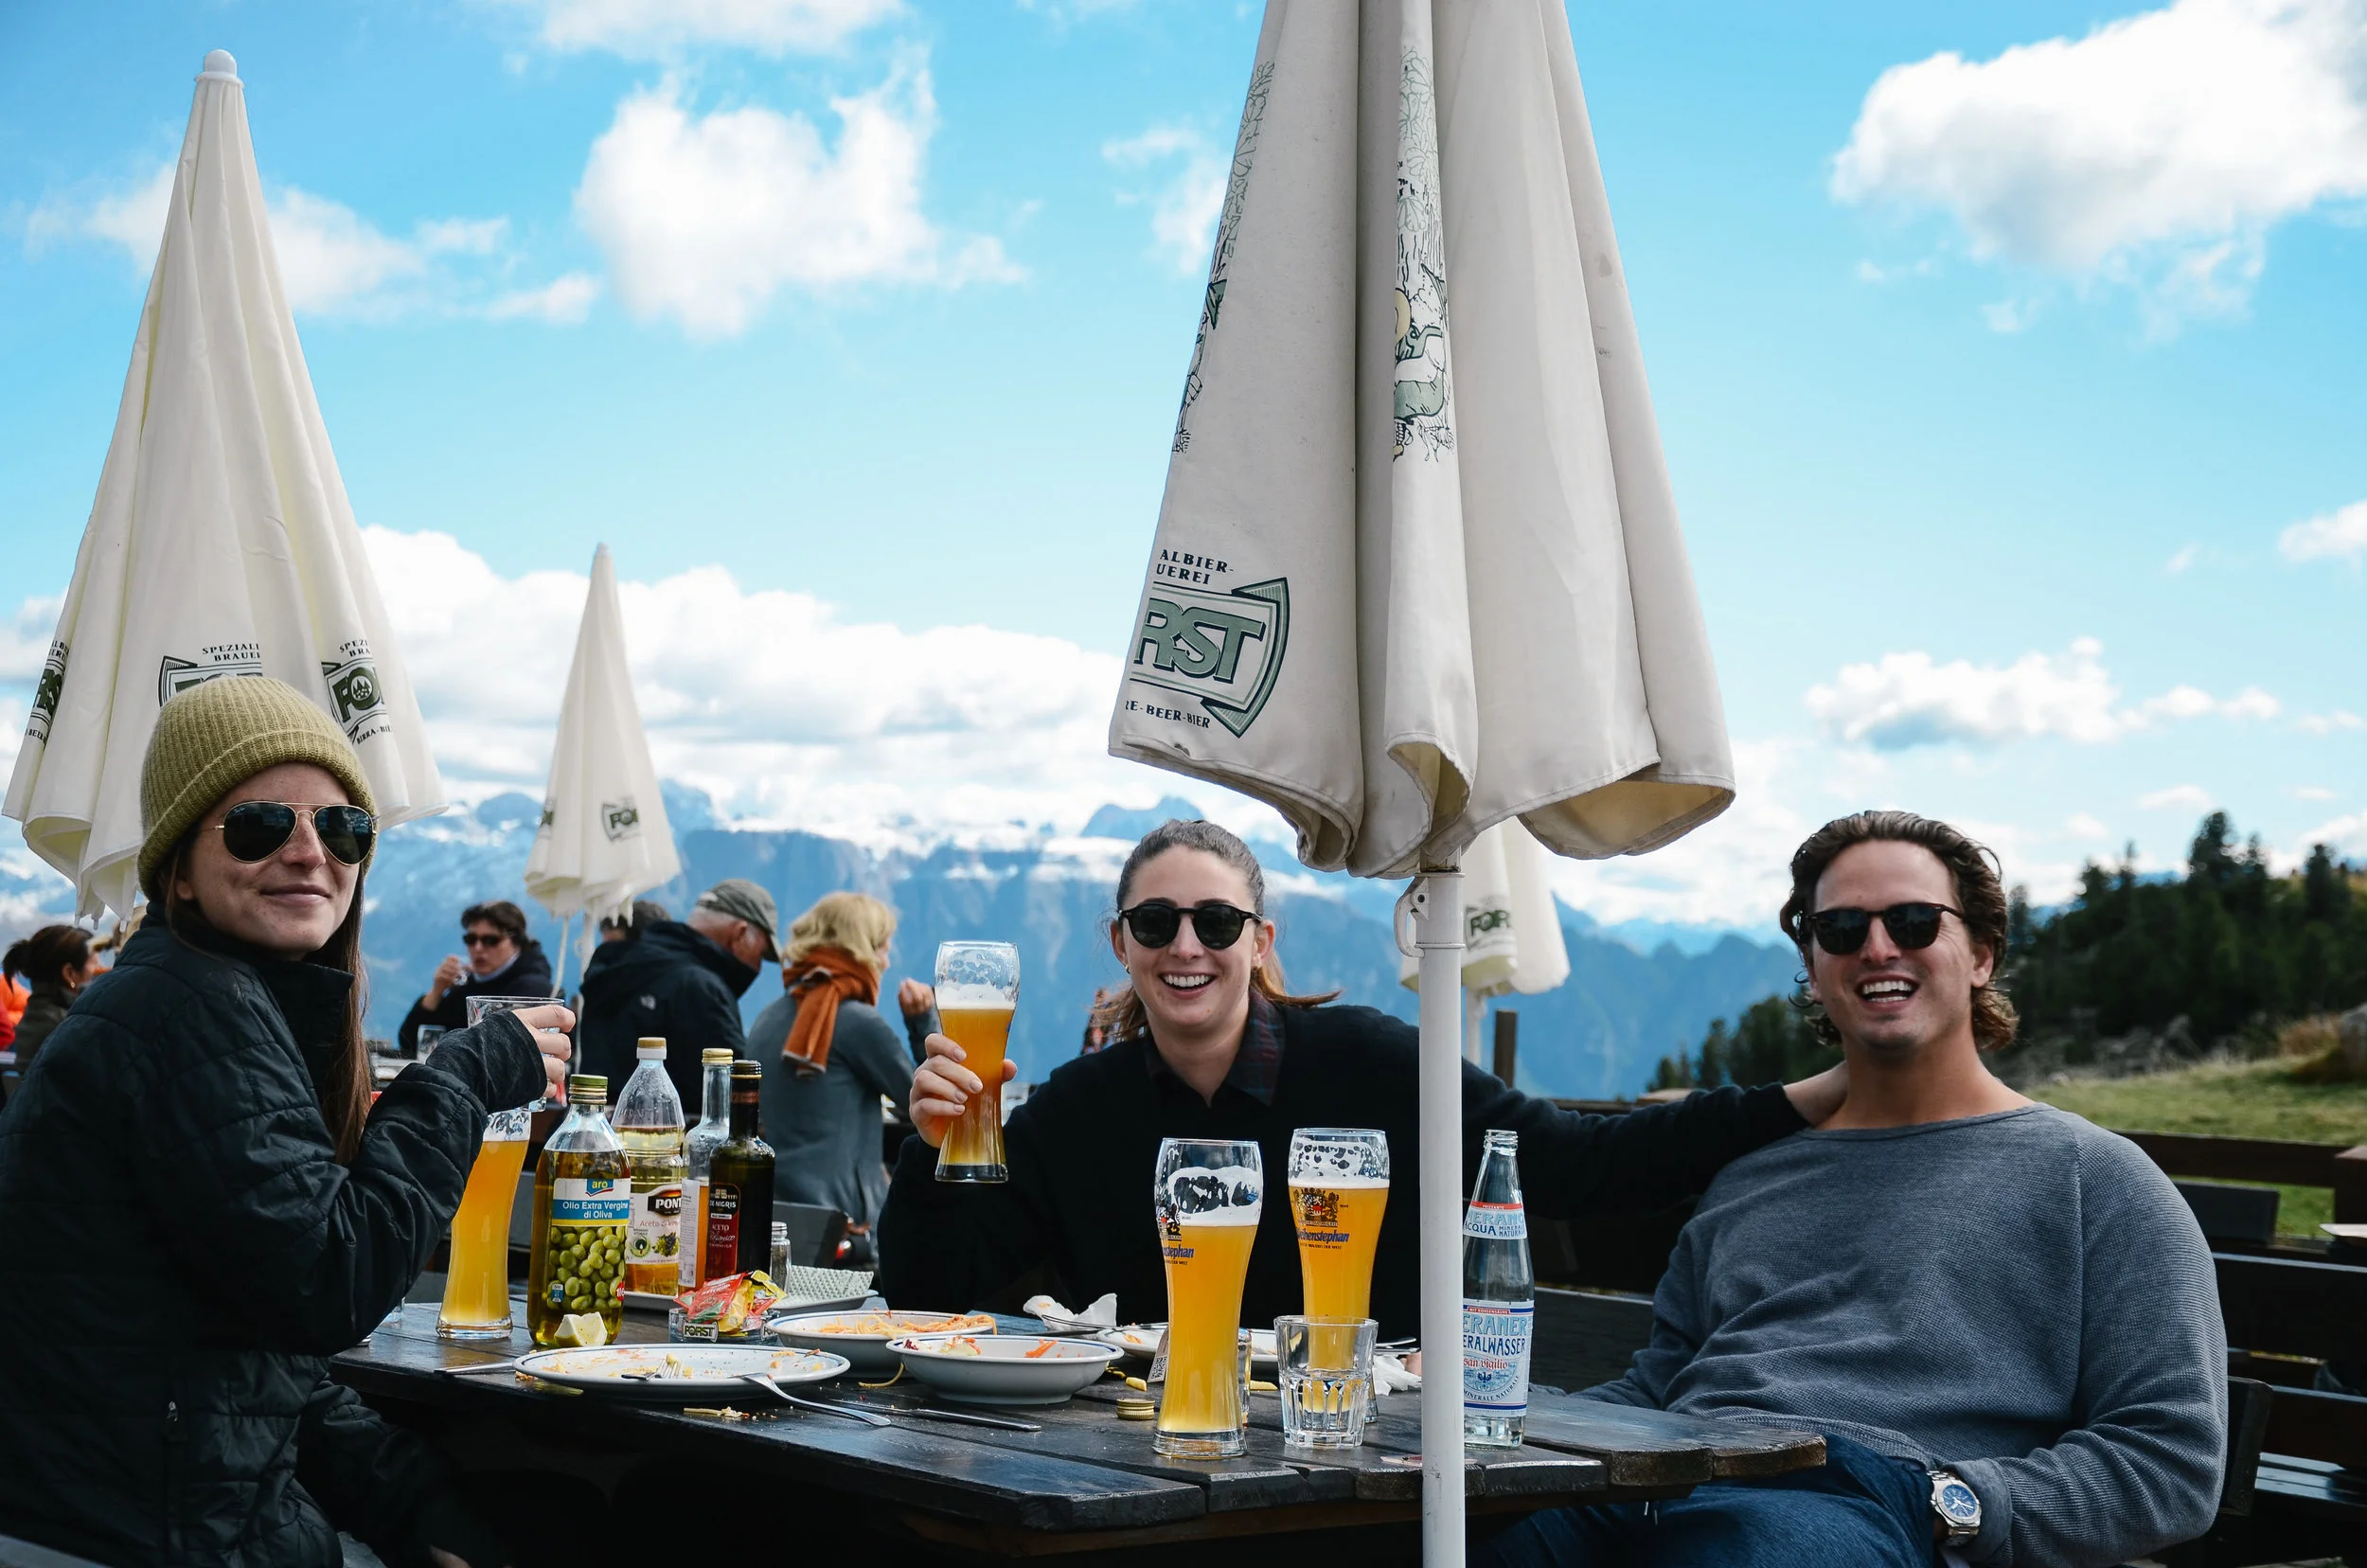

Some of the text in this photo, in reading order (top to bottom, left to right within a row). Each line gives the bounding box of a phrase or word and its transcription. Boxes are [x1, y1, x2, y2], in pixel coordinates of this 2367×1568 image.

[1160, 549, 1234, 574] ALBIER-
[1156, 563, 1211, 585] UEREI
[592, 1181, 608, 1189] aro
[562, 1202, 579, 1210] Olio
[582, 1202, 602, 1210] Extra
[685, 1327, 715, 1337] FORST
[1481, 1358, 1508, 1370] vigilio
